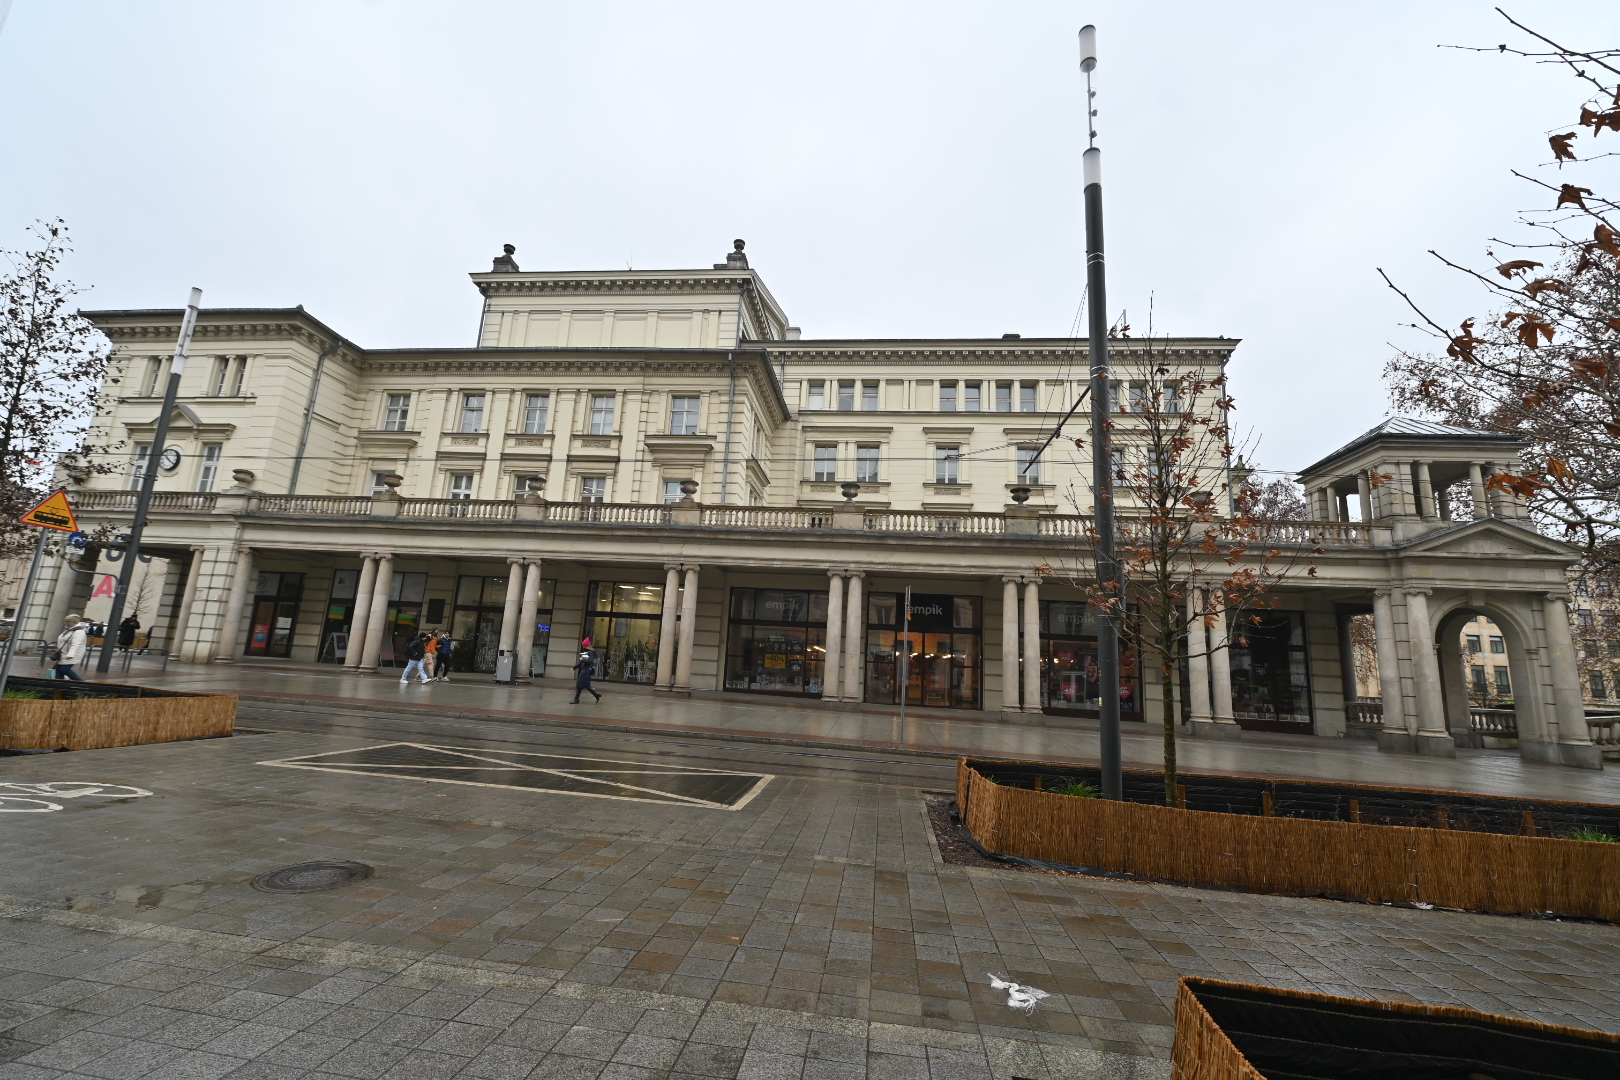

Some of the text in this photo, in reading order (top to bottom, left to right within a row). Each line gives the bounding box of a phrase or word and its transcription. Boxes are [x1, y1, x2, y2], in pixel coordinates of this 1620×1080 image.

[765, 598, 799, 610] empik
[908, 603, 943, 616] empik
[1057, 611, 1096, 624] empik
[766, 654, 785, 663] -40%
